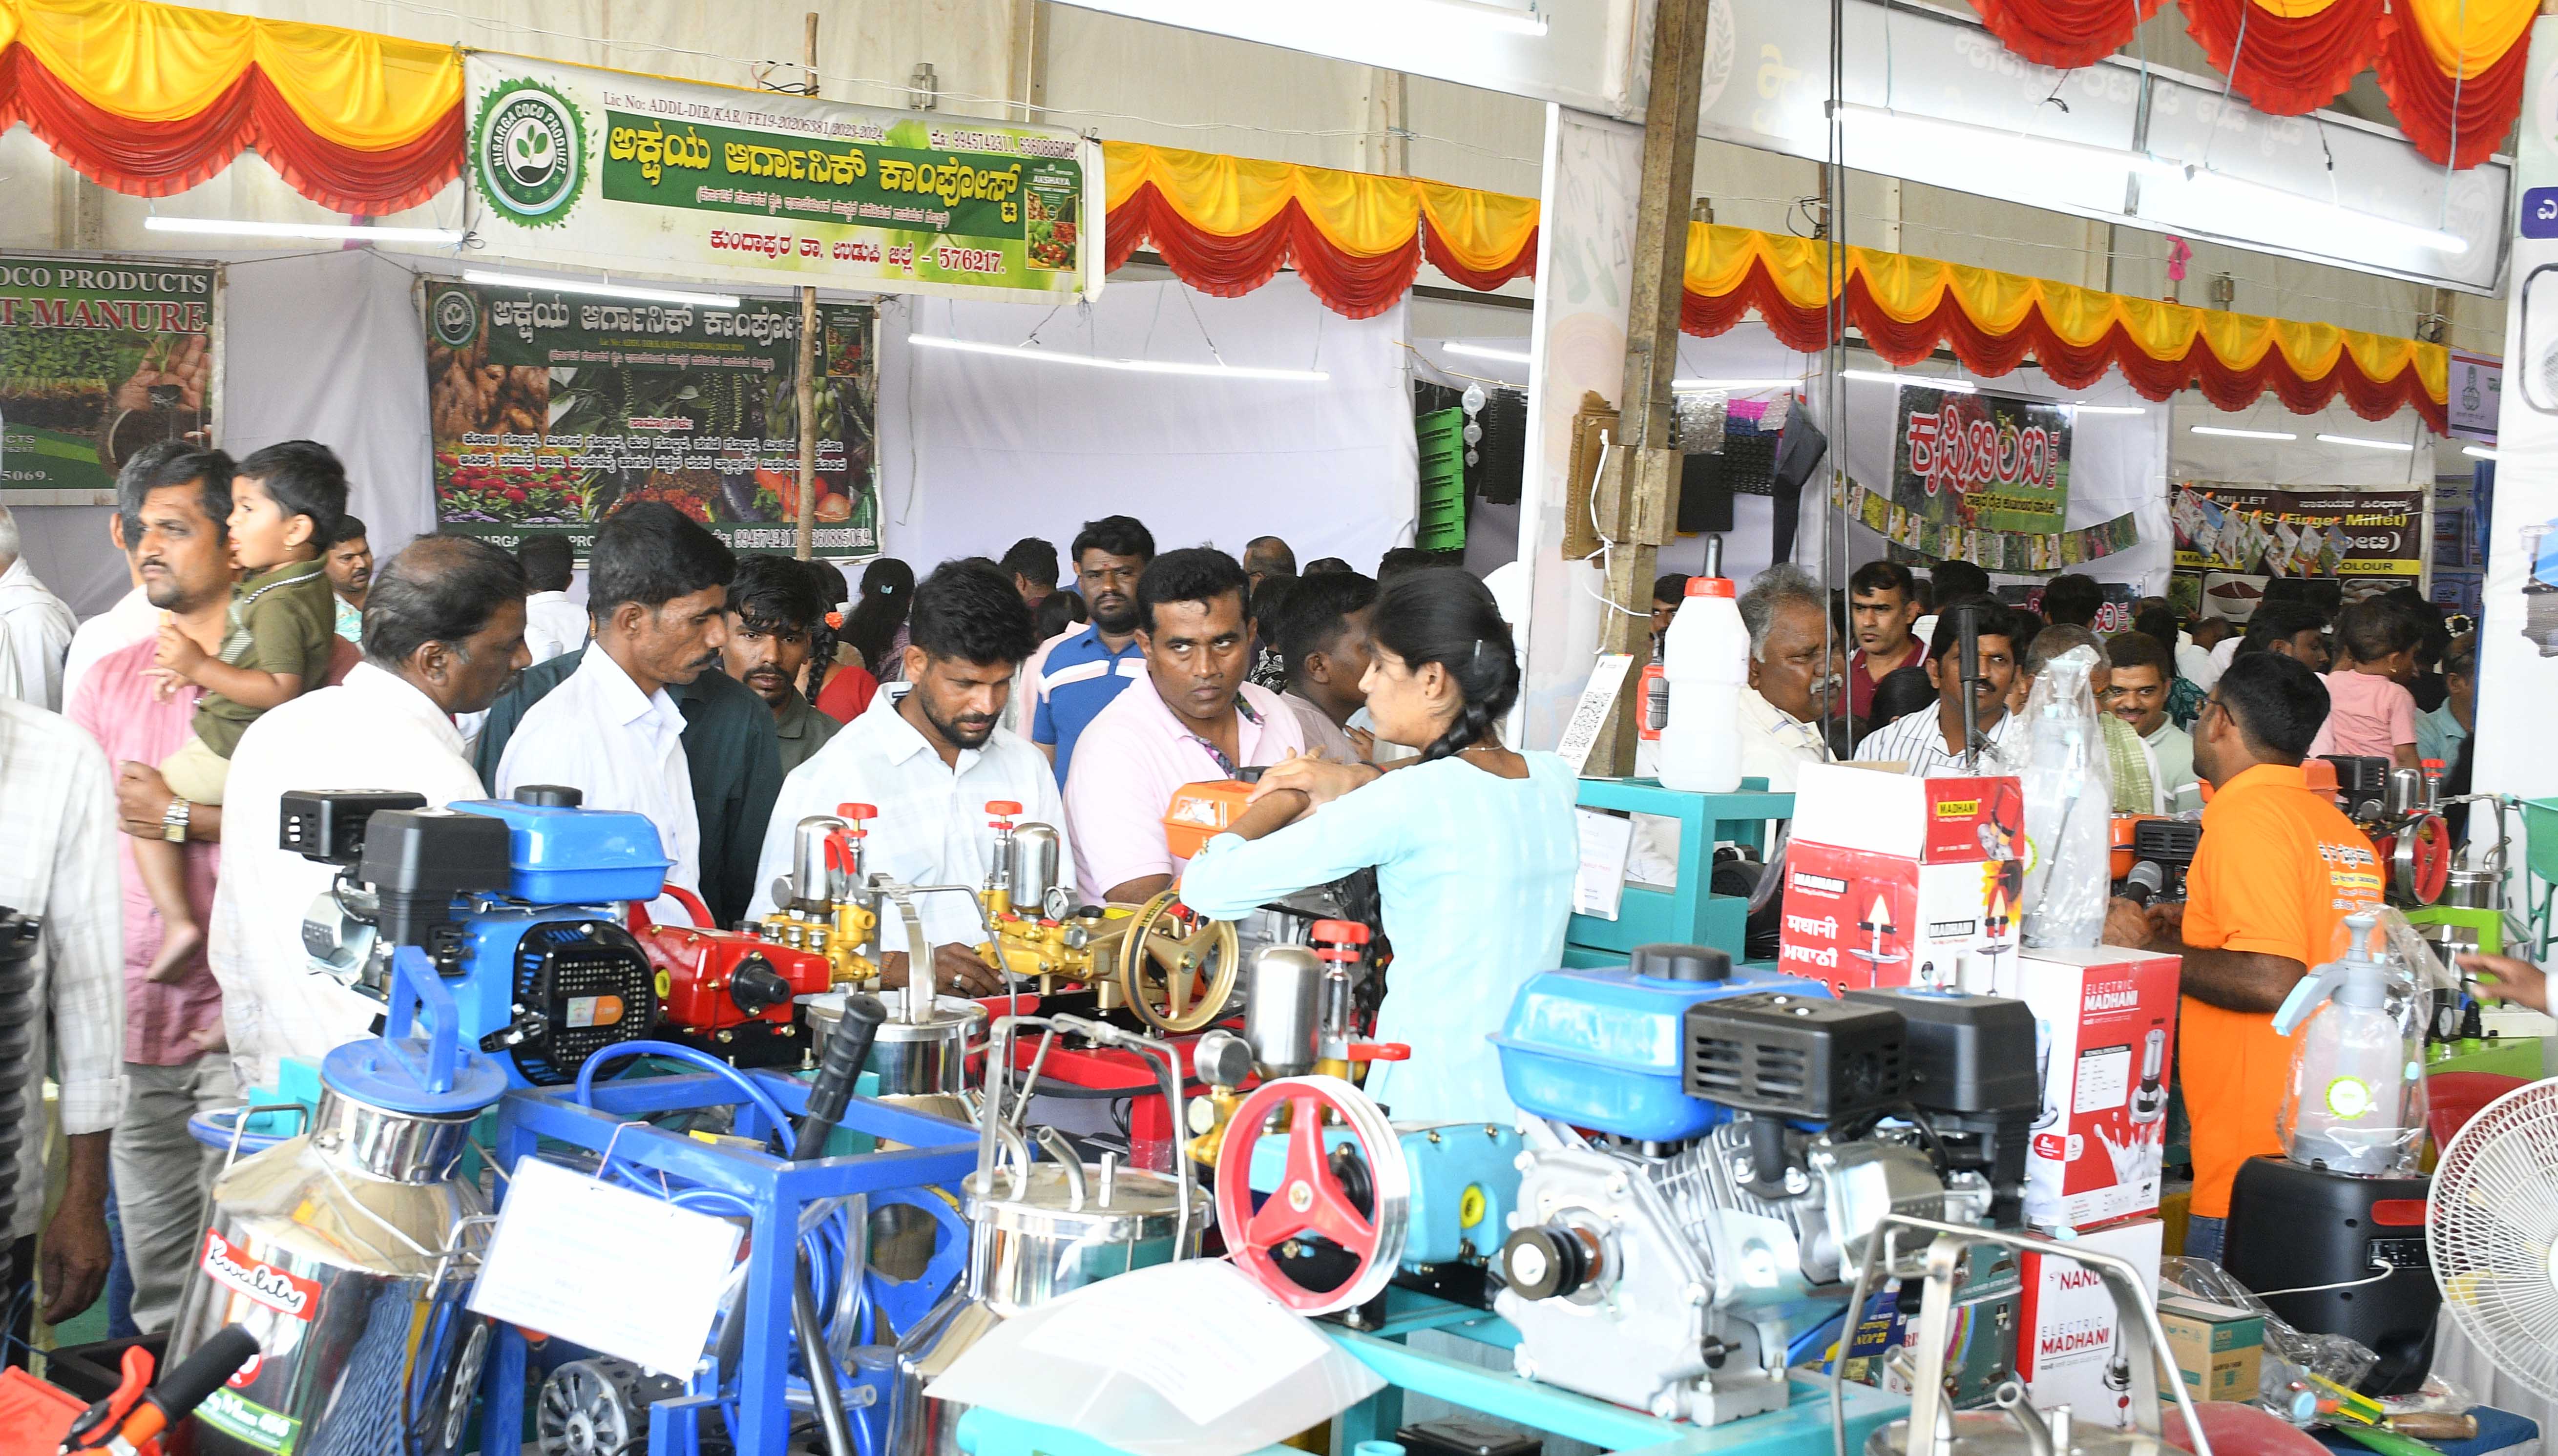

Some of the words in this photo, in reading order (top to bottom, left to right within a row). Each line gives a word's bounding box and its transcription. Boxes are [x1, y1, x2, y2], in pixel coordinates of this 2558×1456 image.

[603, 92, 621, 106] Lic
[625, 95, 645, 110] No:
[492, 111, 517, 167] NISARGA
[514, 103, 545, 119] COCO
[543, 112, 567, 174] PRODUCT
[609, 121, 711, 186] ಅಕ್ಷಯ
[879, 156, 1022, 224] ಕಾಂಪೋಸ್ಟ್
[711, 226, 793, 260] ಕುಂದಾಪುರ
[800, 237, 824, 260] ತಾ.
[833, 238, 881, 264] ಉಡುಪಿ
[889, 241, 914, 274] ಜಿಲ್ಲೆ
[939, 245, 1006, 274] 576217.
[59, 269, 208, 294] PRODUCTS
[29, 298, 208, 335] MANURE
[493, 292, 570, 343] ಅಕ್ಷಯ
[0, 470, 54, 481] 5069.
[2216, 495, 2268, 505] MILLET
[2281, 513, 2342, 529] Finge
[2345, 513, 2407, 527] Millet)
[2338, 562, 2393, 570] OLOUR
[2085, 979, 2134, 995] ELECTRIC
[2083, 990, 2139, 1012] MADHANI
[2041, 1316, 2102, 1337] ELECTRIC
[2040, 1327, 2110, 1355] MADHANI
